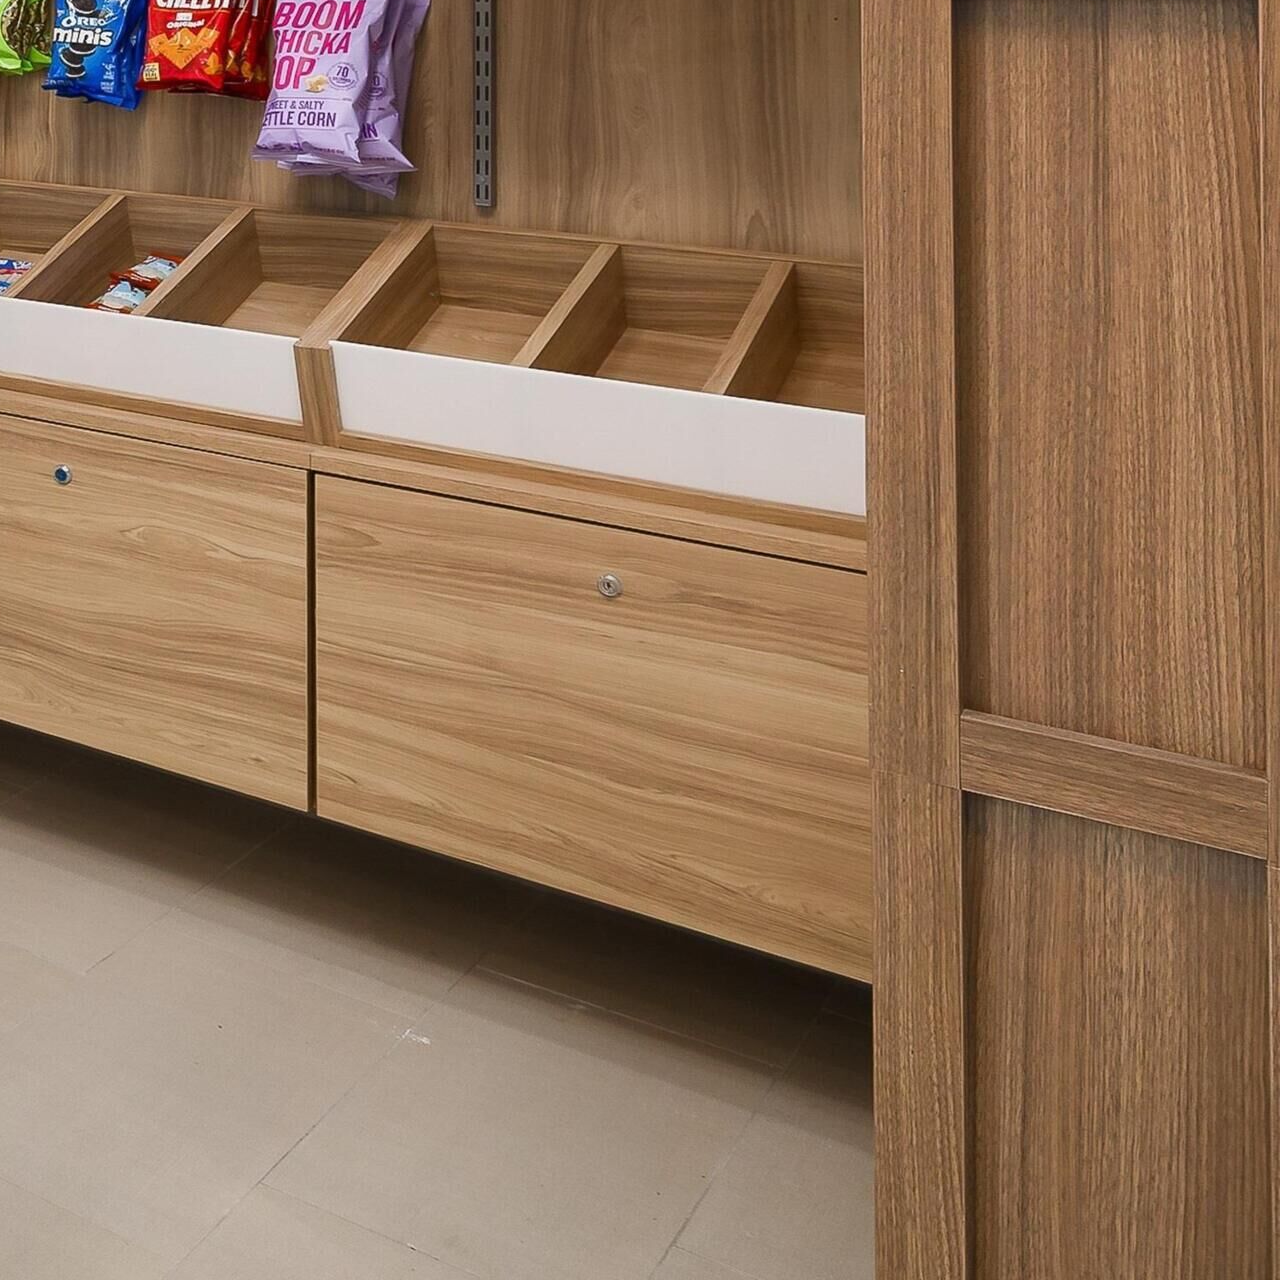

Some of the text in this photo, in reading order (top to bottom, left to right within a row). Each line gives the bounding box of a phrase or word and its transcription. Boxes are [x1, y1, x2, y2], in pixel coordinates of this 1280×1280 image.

[61, 16, 106, 27] OREO
[272, 0, 367, 31] BOOM
[53, 27, 113, 46] minis
[336, 66, 349, 77] 70
[298, 100, 325, 111] SALTY
[297, 111, 336, 128] CORN
